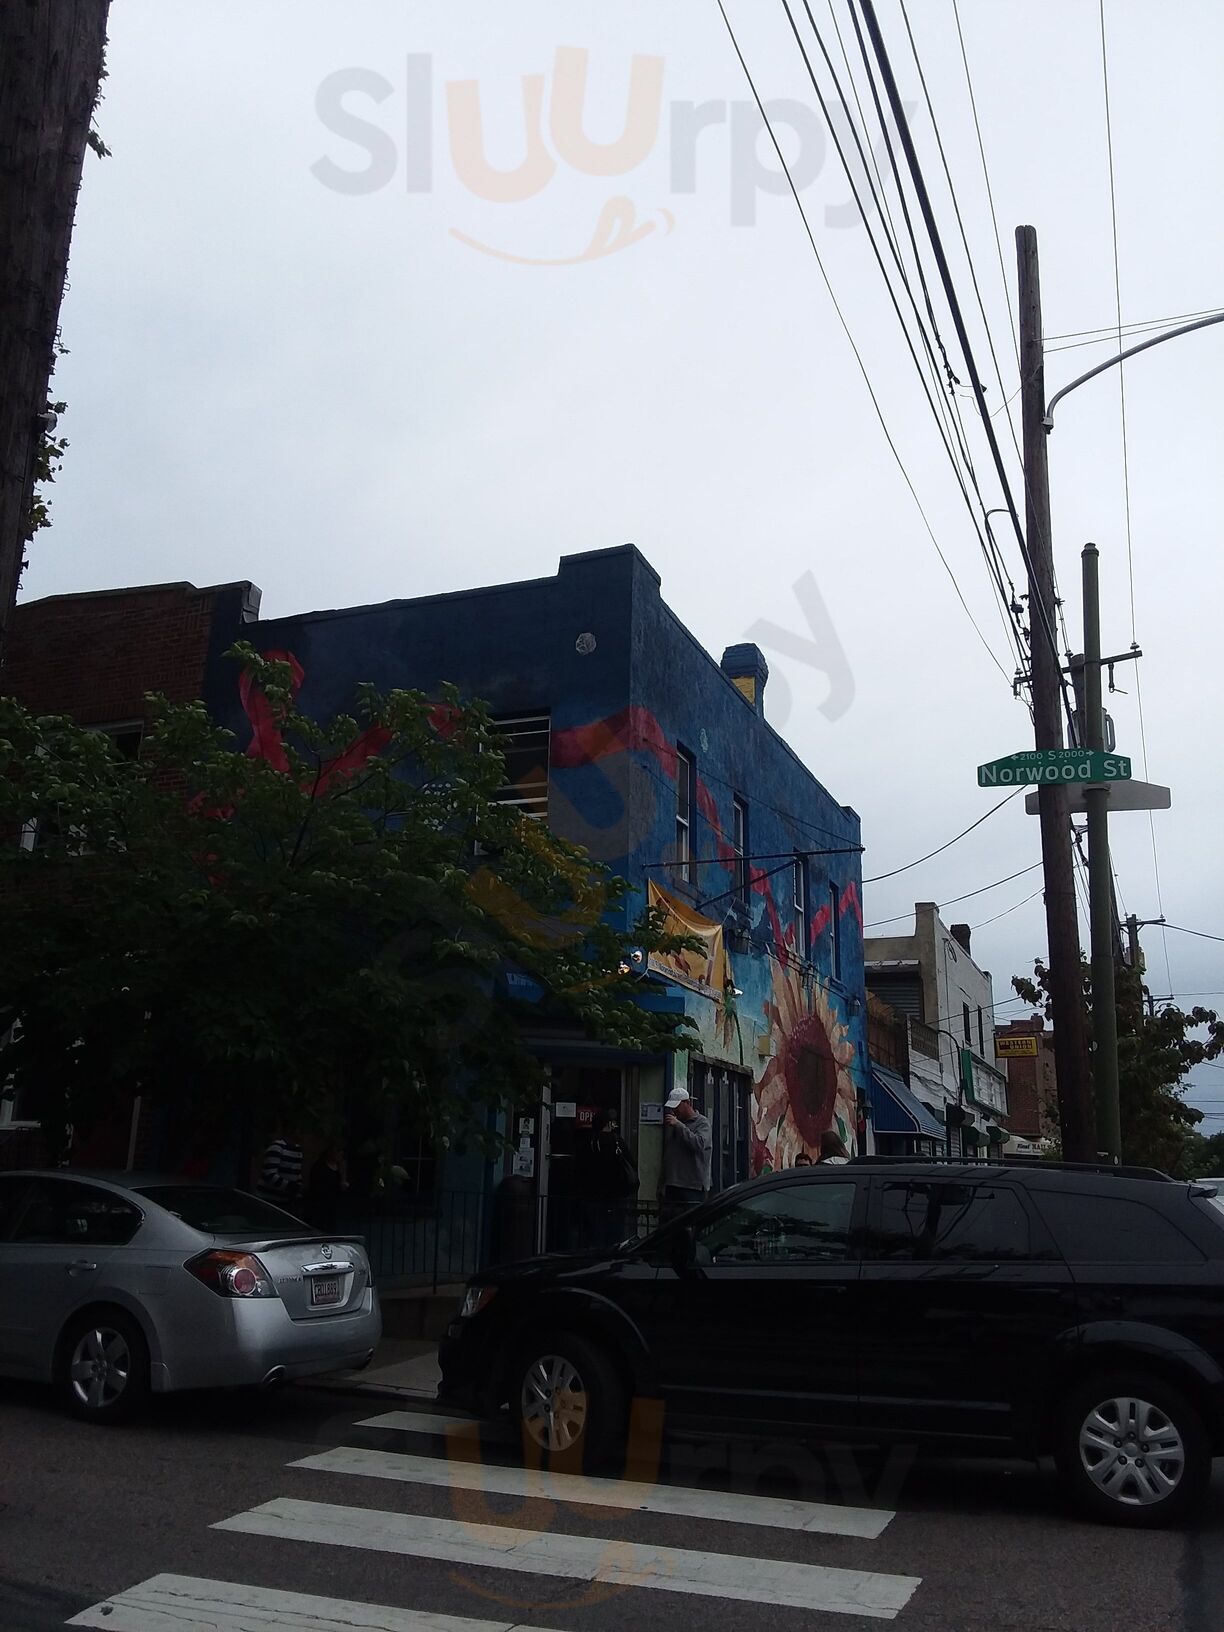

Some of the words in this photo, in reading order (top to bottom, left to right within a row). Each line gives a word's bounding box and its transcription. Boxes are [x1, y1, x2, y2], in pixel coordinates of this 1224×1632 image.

[1020, 751, 1043, 761] 2100
[1048, 750, 1056, 760] S
[1058, 749, 1084, 758] 2000
[981, 760, 1091, 784] Norwood
[1103, 759, 1128, 777] St
